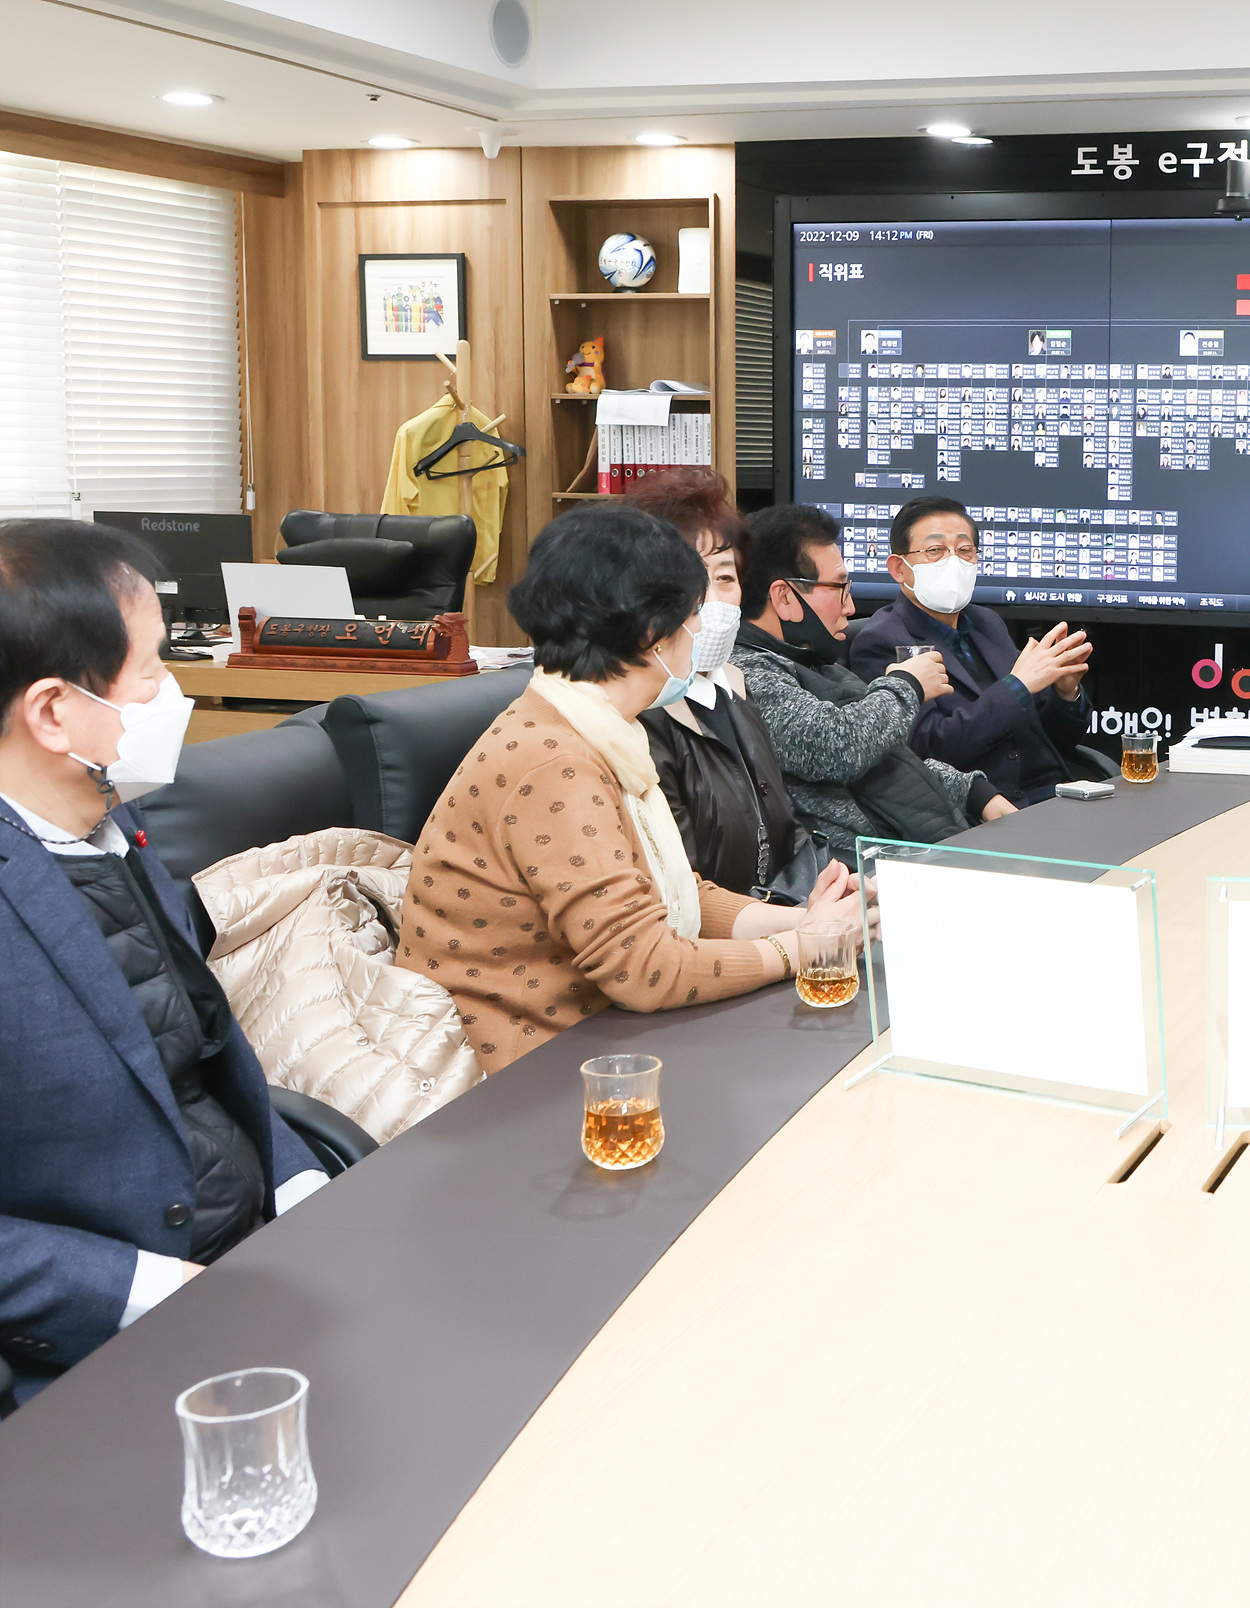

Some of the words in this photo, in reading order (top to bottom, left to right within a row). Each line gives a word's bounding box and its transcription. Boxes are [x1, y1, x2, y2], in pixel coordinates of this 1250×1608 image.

[1071, 143, 1140, 180] 도봉
[799, 230, 860, 242] 2022-12-09
[869, 229, 898, 241] 14:12
[899, 230, 913, 239] PM
[915, 229, 934, 241] (FRI)
[818, 262, 865, 282] 직위표
[141, 517, 200, 532] Redstone
[1024, 591, 1047, 601] 실시간
[1049, 592, 1065, 602] 도시
[1096, 593, 1129, 604] 구정지표
[1199, 597, 1224, 607] 조직도
